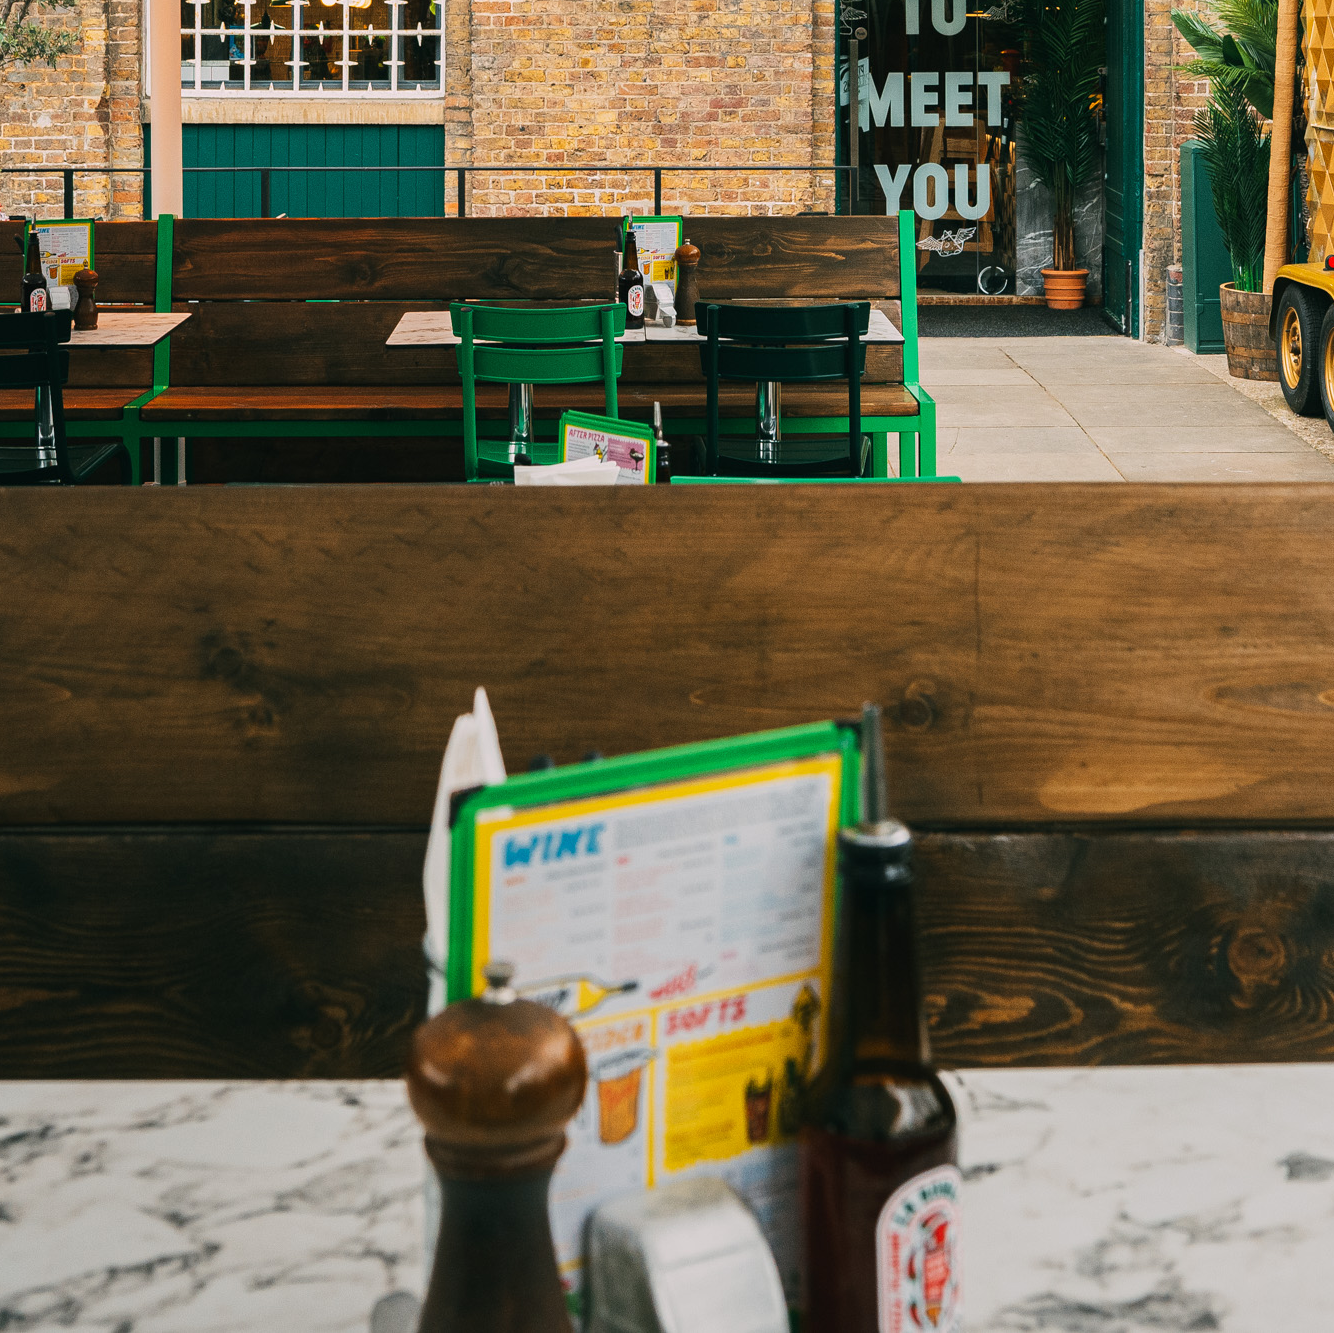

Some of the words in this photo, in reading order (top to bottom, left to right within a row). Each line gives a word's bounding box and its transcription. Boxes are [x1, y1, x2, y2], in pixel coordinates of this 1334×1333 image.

[857, 71, 1011, 127] MEET
[873, 162, 991, 221] YOU
[569, 429, 587, 439] AFTER
[588, 433, 604, 442] PIZZA
